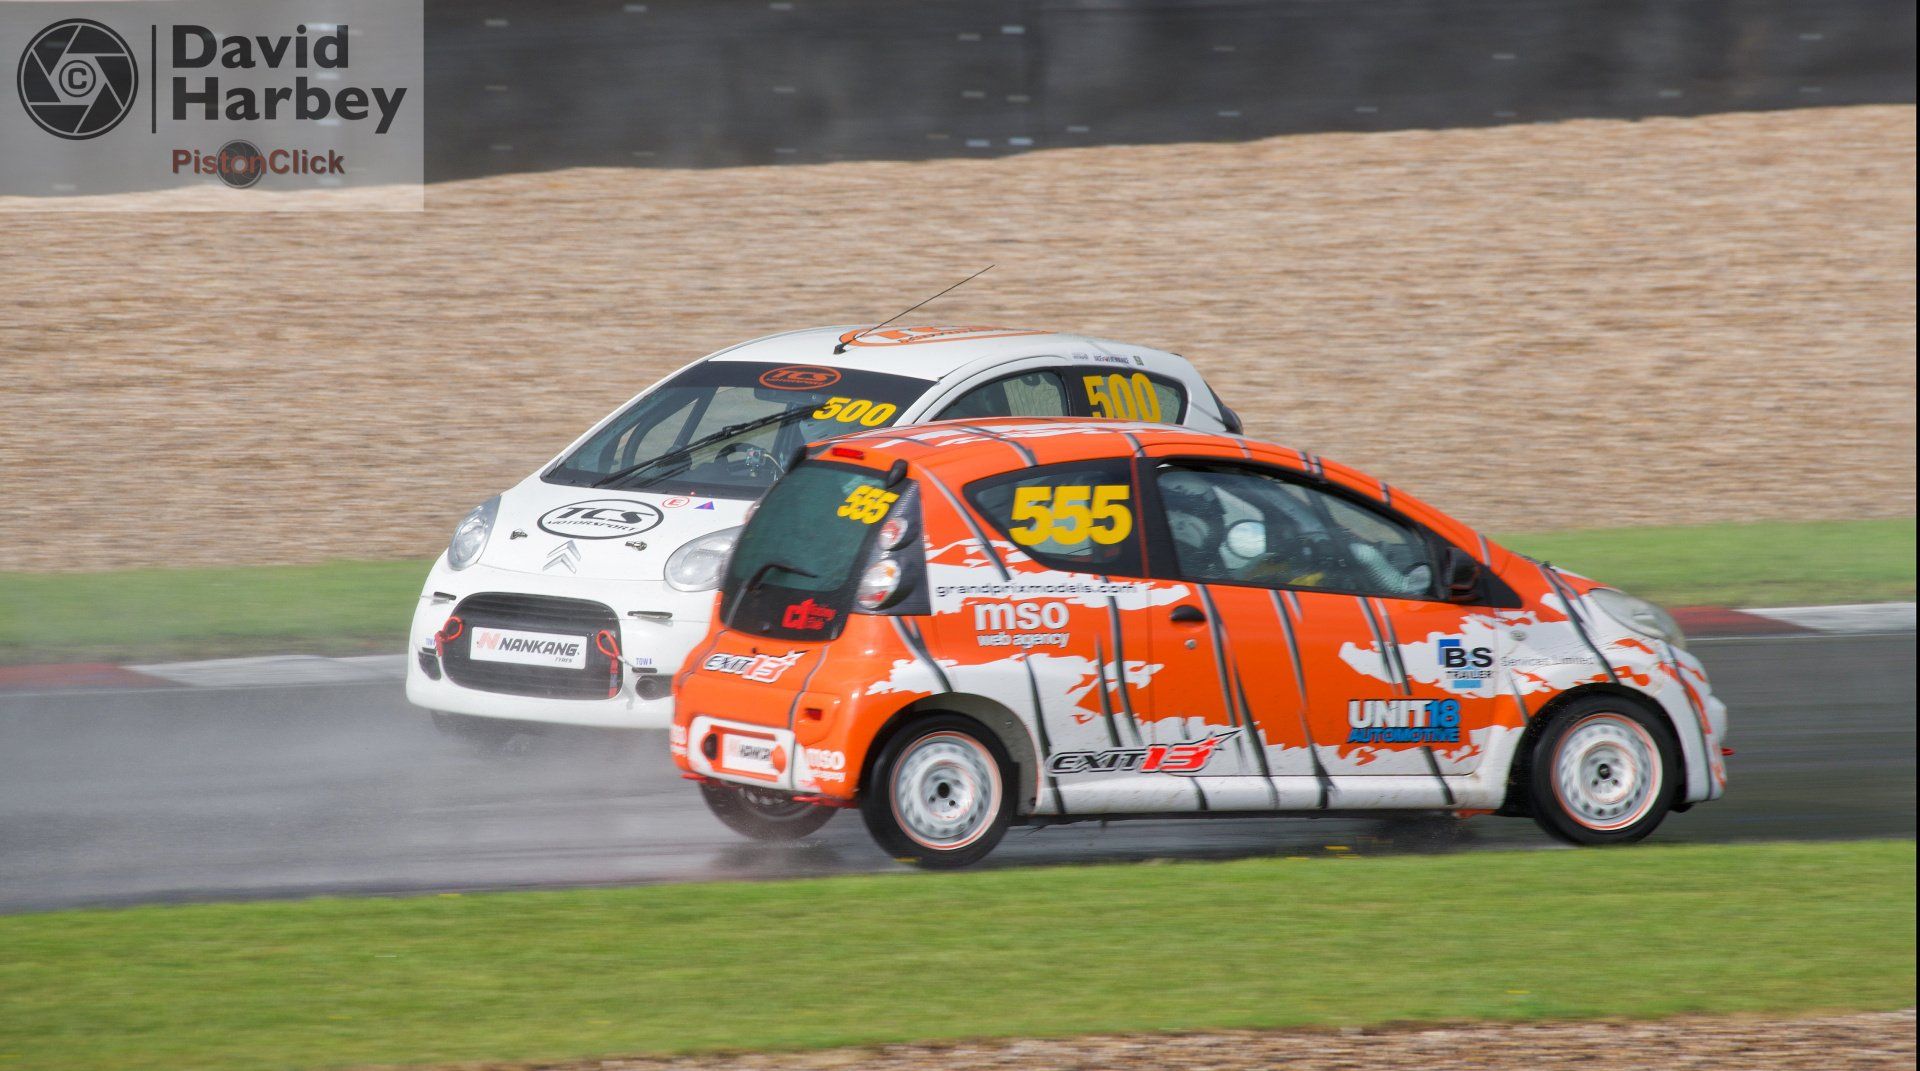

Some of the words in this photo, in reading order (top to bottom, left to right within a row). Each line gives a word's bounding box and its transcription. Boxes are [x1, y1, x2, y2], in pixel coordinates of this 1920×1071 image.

[1082, 372, 1161, 423] 500
[812, 396, 897, 427] 500
[556, 507, 655, 524] TCS
[836, 484, 900, 524] 555
[1008, 484, 1133, 546] 555
[547, 519, 639, 532] MOTORSPORT
[935, 583, 1138, 597] grandprixmodels.com
[974, 601, 1070, 631] mso
[498, 638, 580, 657] NANKANG
[976, 632, 1012, 647] web
[1013, 632, 1070, 648] agency
[1446, 671, 1493, 679] TRAILER
[1347, 698, 1461, 729] UNIT18
[1346, 727, 1460, 743] AUTOMOTIVE
[1047, 744, 1214, 773] EXIT13
